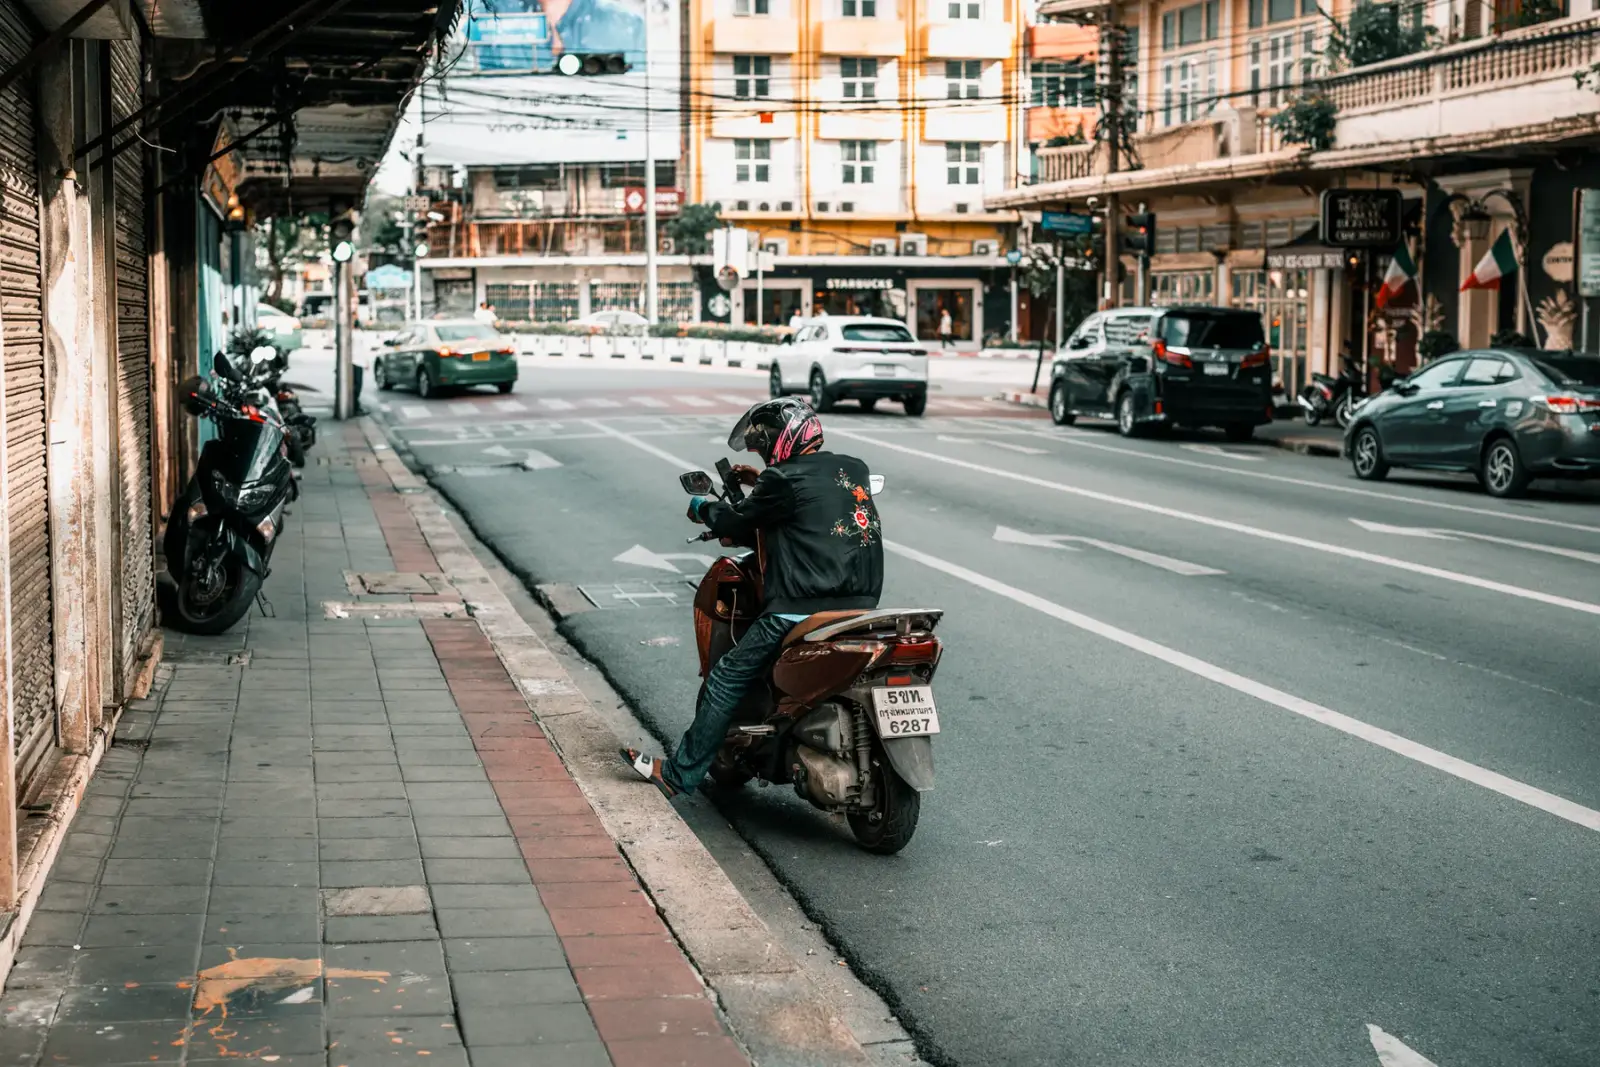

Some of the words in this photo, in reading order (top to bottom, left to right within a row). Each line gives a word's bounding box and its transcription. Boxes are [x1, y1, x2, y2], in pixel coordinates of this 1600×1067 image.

[826, 278, 894, 289] STARBUCKS
[879, 707, 934, 719] กรุงเทพมหานคร
[890, 719, 931, 734] 6287
